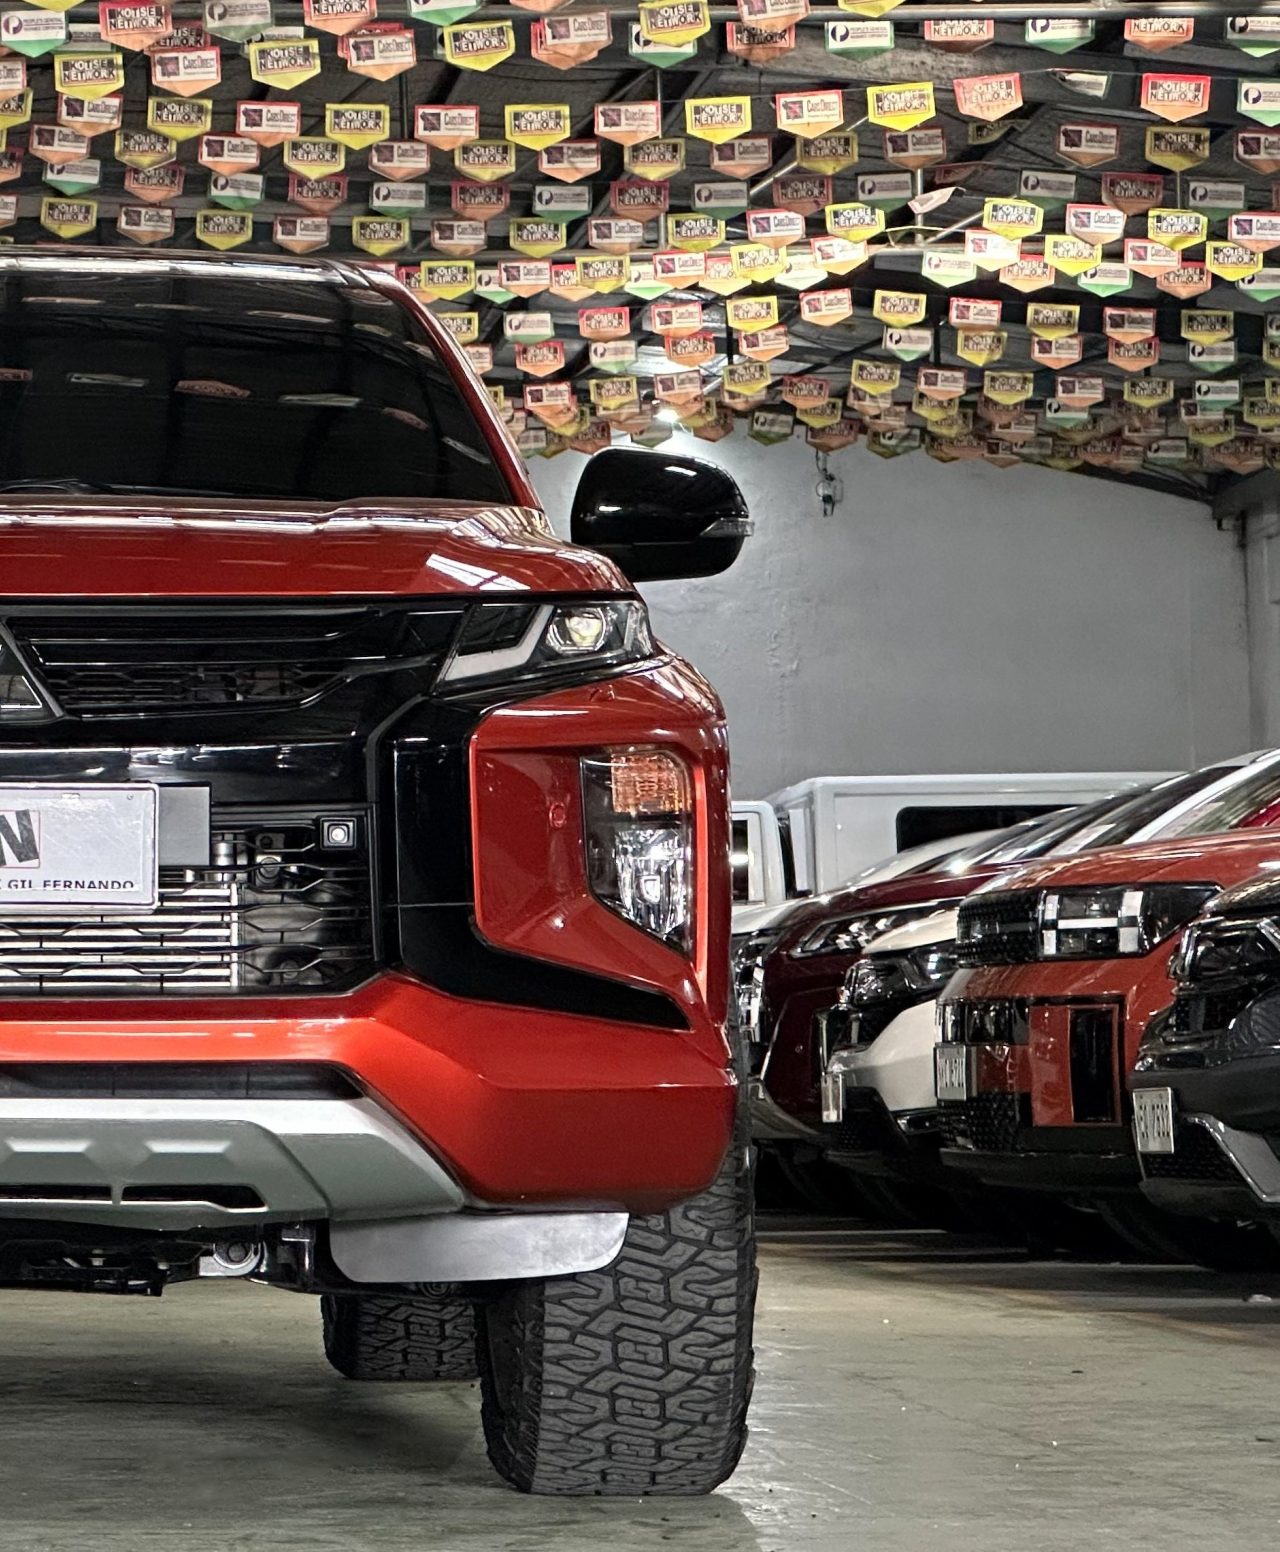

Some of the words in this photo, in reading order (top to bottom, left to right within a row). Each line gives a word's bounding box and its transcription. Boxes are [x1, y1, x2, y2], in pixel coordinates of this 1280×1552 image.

[116, 5, 156, 18] KOTSE
[313, 1, 367, 15] NETWORK
[655, 3, 693, 18] KOTSE
[109, 15, 163, 28] NETWORK
[649, 11, 701, 28] NETWORK
[460, 27, 498, 42] KOTSE
[454, 35, 506, 52] NETWORK
[265, 46, 303, 59] KOTSE
[69, 58, 107, 71] KOTSE
[259, 54, 311, 69] NETWORK
[63, 66, 115, 81] NETWORK
[42, 879, 135, 890] FERNANDO
